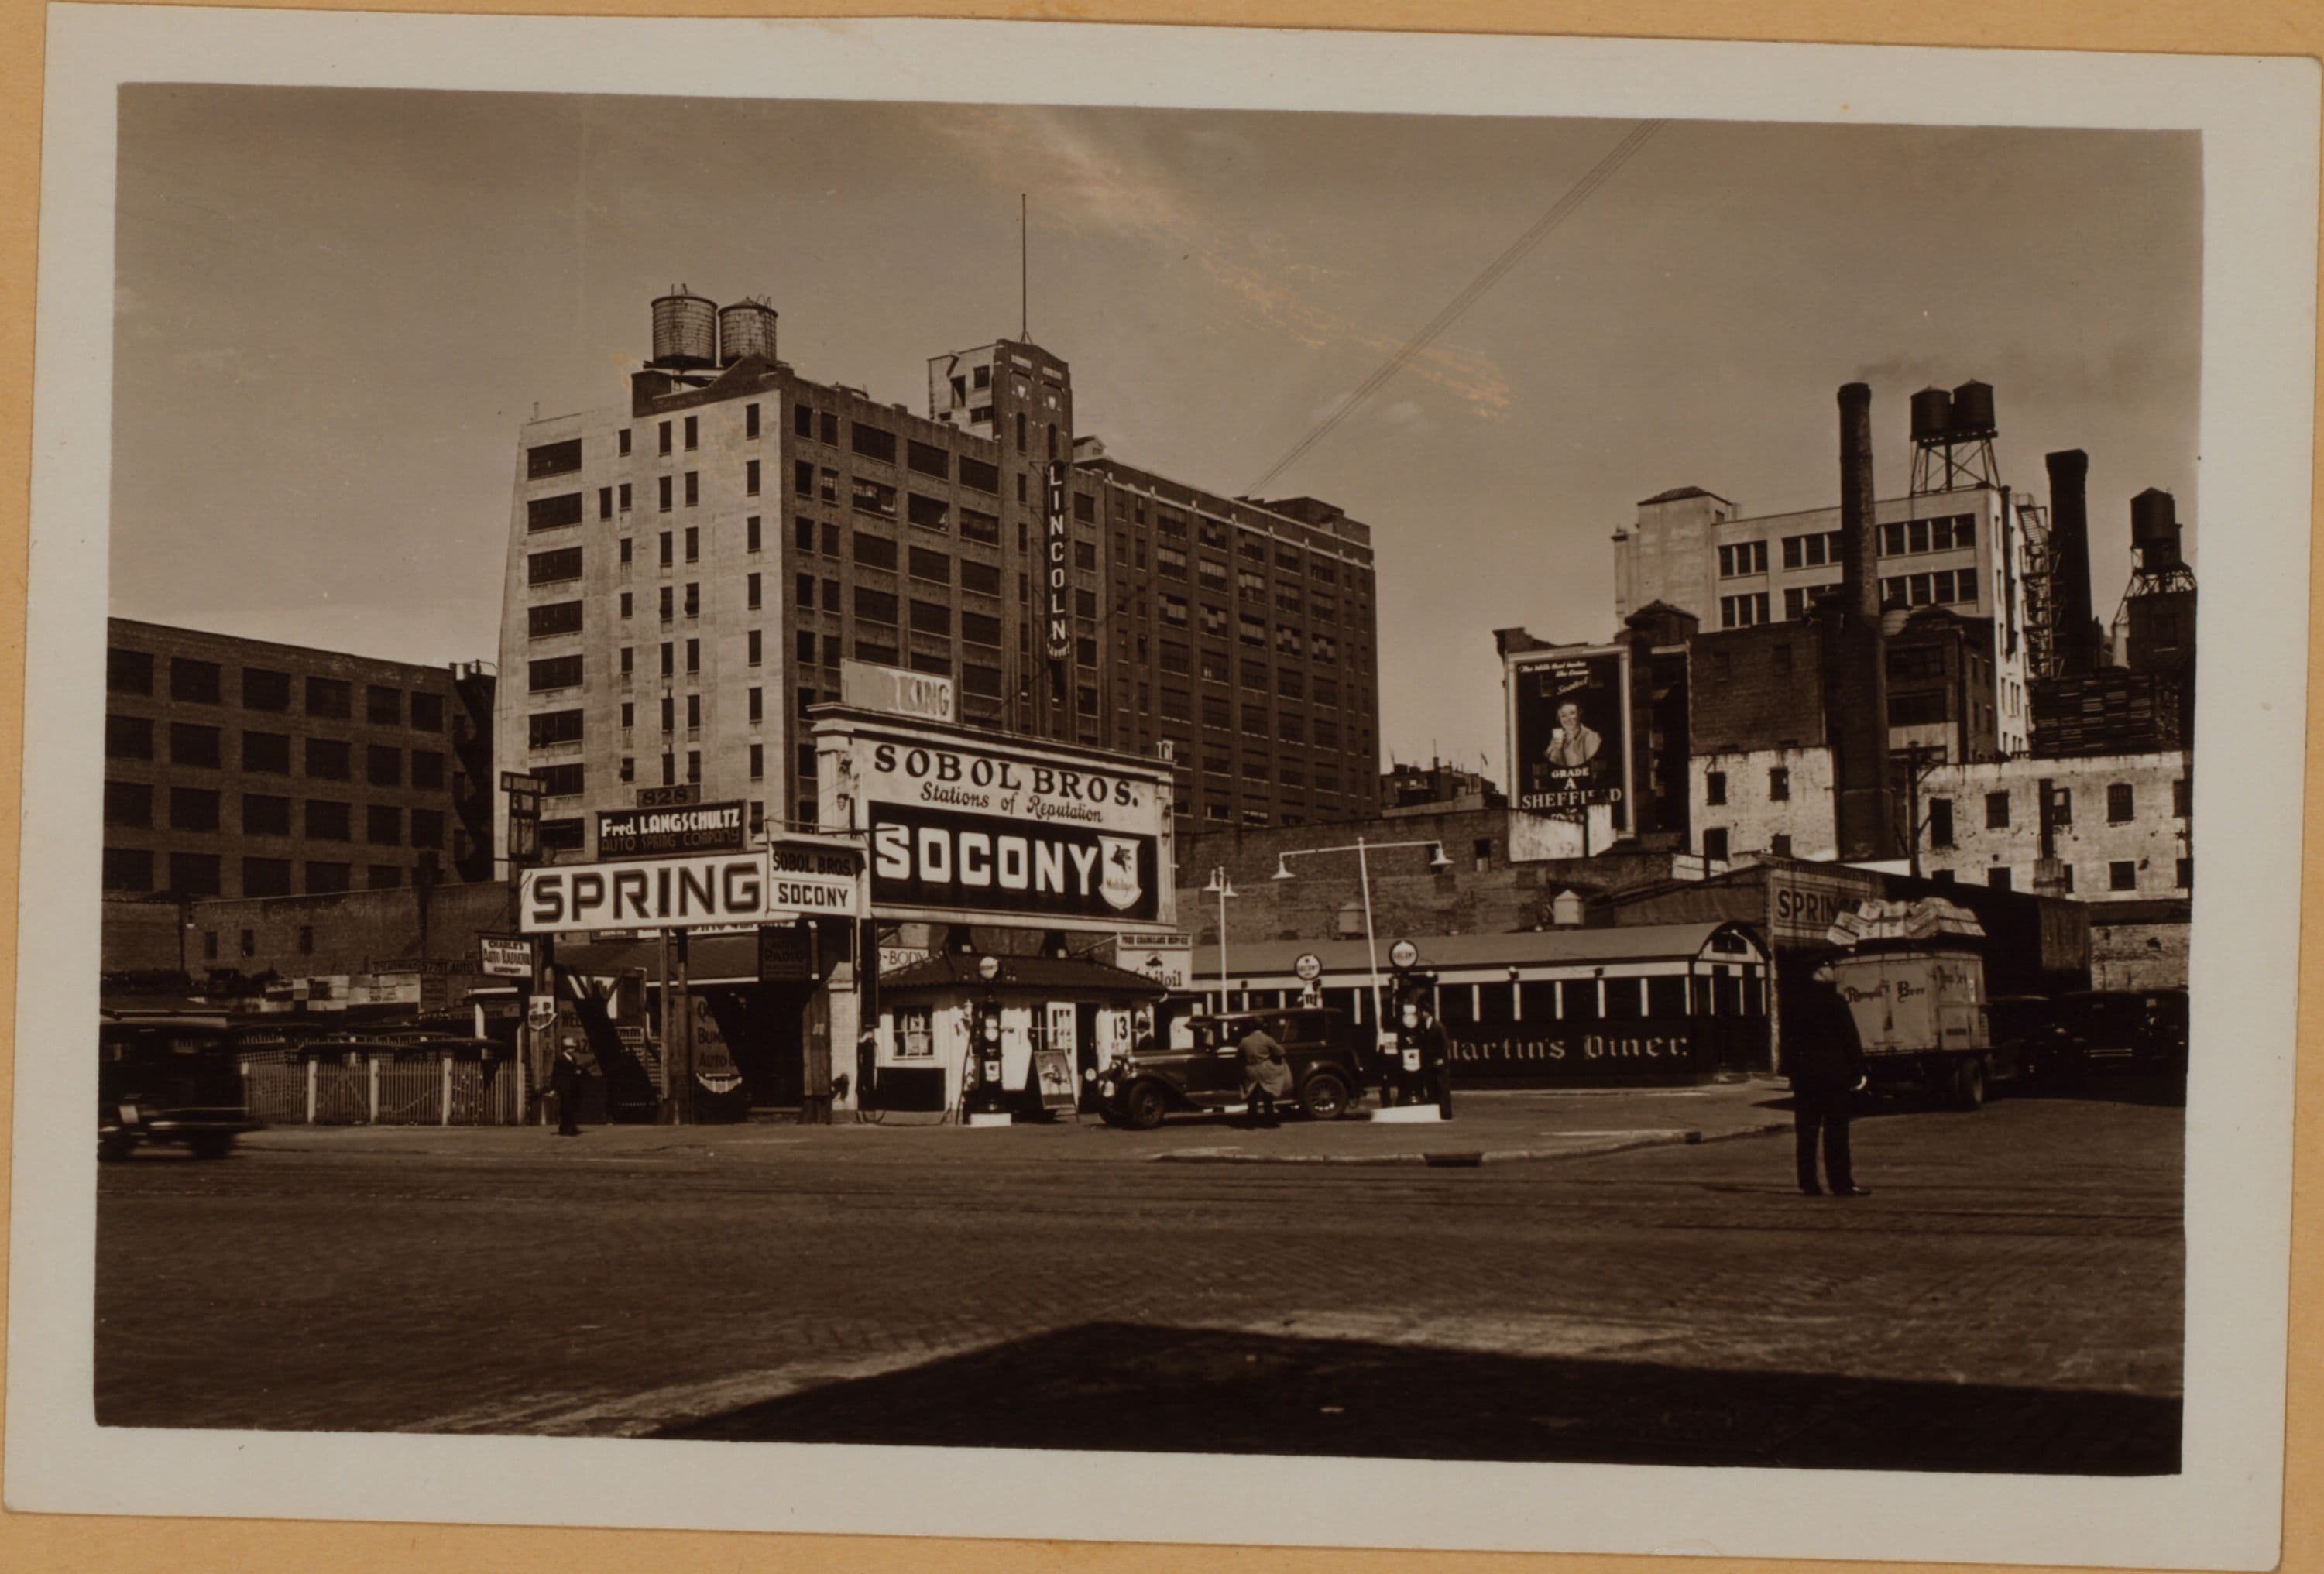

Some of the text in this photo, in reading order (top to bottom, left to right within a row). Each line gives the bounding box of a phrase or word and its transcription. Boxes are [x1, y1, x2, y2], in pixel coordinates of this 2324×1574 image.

[1049, 465, 1066, 640] LINCOLN
[875, 745, 1138, 807] SOBOL BROS.
[1551, 767, 1590, 779] GRADE
[1564, 777, 1577, 790] A
[641, 790, 688, 808] 828
[920, 781, 1103, 823] Stations of Reputation
[1522, 787, 1622, 809] SHEFFID
[640, 807, 740, 834] LANGSCHULTZ
[601, 827, 740, 852] AUTO SPRING COMPANY
[773, 852, 853, 876] SOBOL BROS.
[875, 822, 1098, 897] SOCONY
[533, 862, 760, 923] SPRING
[778, 884, 849, 908] SOCONY
[483, 948, 501, 963] AUTO
[1897, 980, 1926, 1004] Beer
[1114, 1015, 1128, 1041] 13
